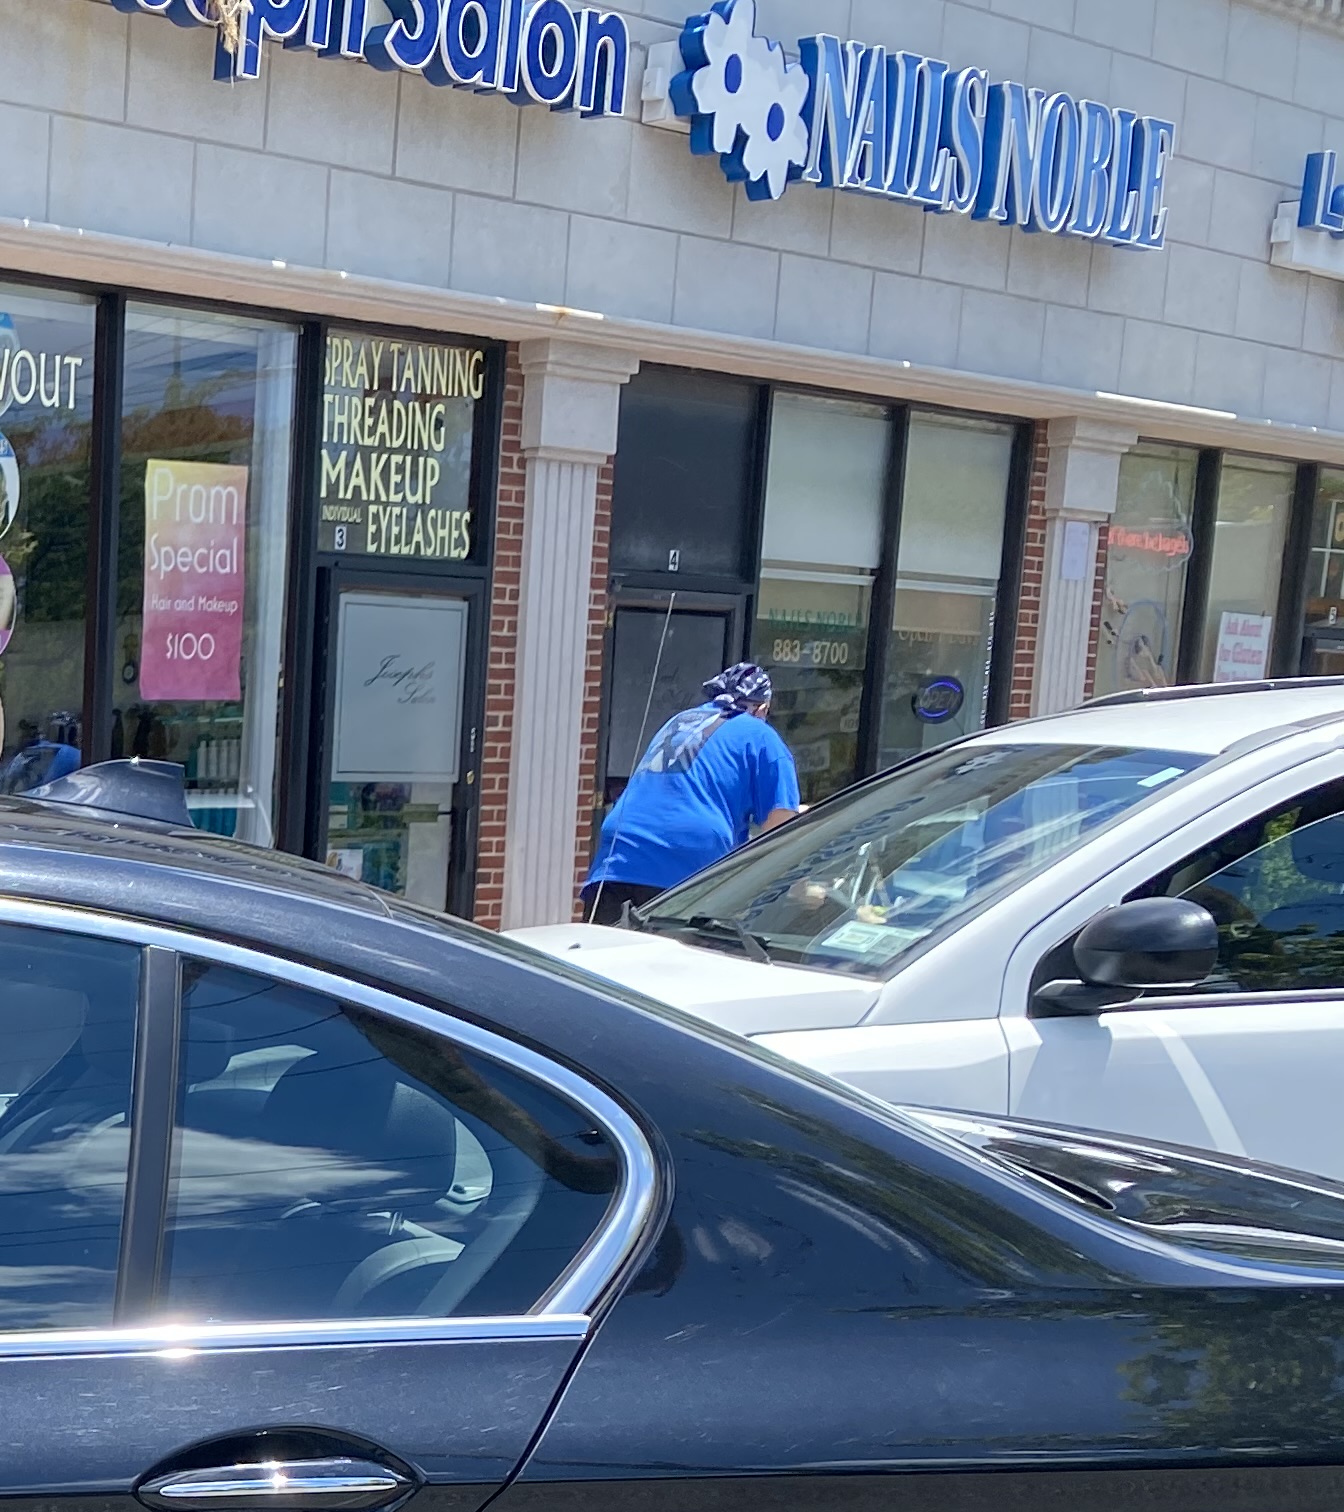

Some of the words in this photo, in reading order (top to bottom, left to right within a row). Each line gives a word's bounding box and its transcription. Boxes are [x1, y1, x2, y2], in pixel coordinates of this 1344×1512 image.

[800, 32, 990, 215] NAILS
[986, 80, 1176, 251] NOBLE
[389, 342, 485, 400] TANNING
[322, 393, 446, 453] THREADING
[151, 467, 239, 526] Prom
[320, 448, 441, 505] MAKEUP
[150, 532, 238, 580] Special
[335, 526, 346, 548] 3
[366, 504, 471, 560] EYELASHES
[670, 551, 678, 570] 4
[151, 593, 171, 611] Hair
[174, 595, 195, 612] and
[197, 596, 239, 616] Makeup
[166, 632, 215, 661] $100
[772, 638, 849, 664] 883-8700
